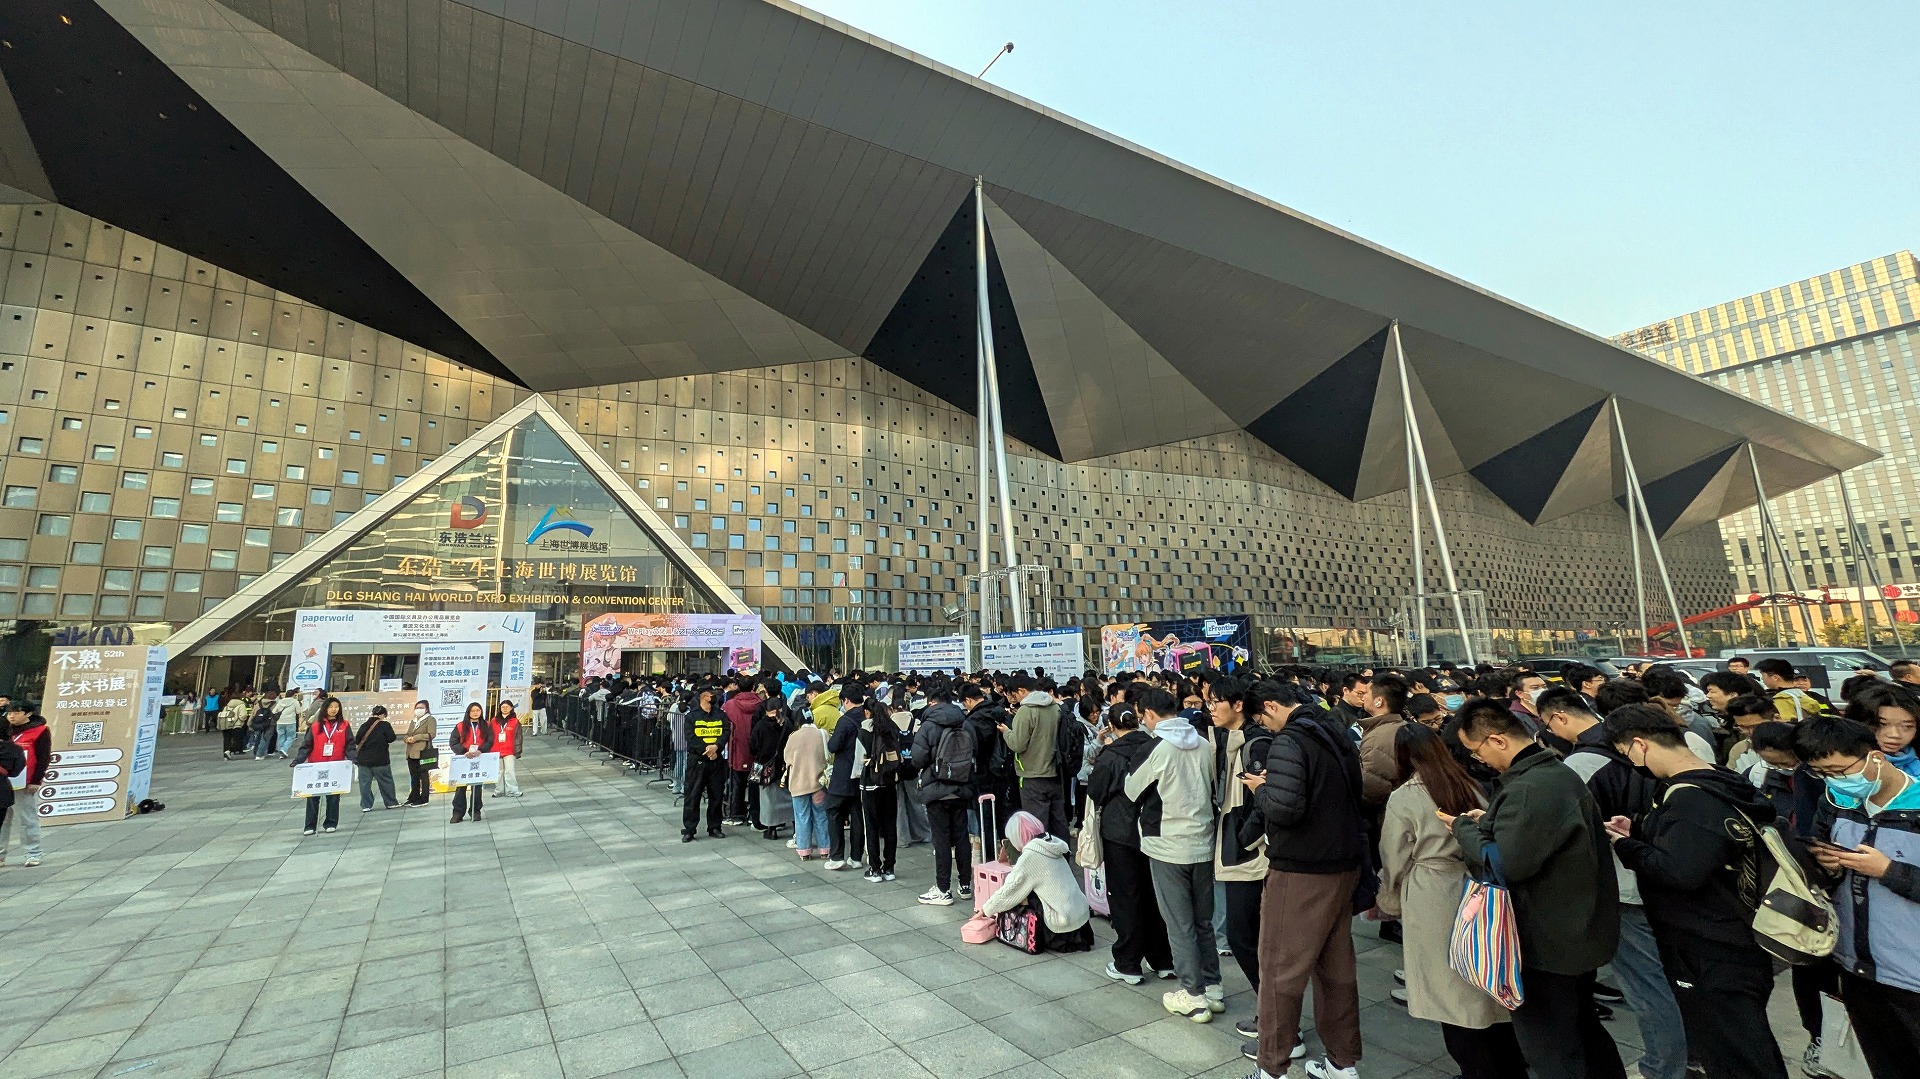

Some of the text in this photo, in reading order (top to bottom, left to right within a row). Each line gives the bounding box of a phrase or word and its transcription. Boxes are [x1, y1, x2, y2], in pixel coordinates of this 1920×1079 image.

[439, 532, 496, 545] 东浩兰生
[540, 538, 608, 552] 上海世博展览馆
[327, 590, 684, 606] DLG SHANG HAI WORLD EXPO EXHIBITION & CONVENTION CENTER
[301, 614, 354, 623] paperworld
[1208, 624, 1238, 632] zFrontier
[104, 650, 125, 658] 52th
[53, 649, 102, 670] 不熟
[429, 669, 479, 677] 观众现场登记
[57, 678, 126, 697] 艺术书展
[56, 698, 128, 709] 观众现场登记
[48, 771, 55, 779] 2
[45, 788, 53, 796] 3
[42, 805, 50, 813] 4
